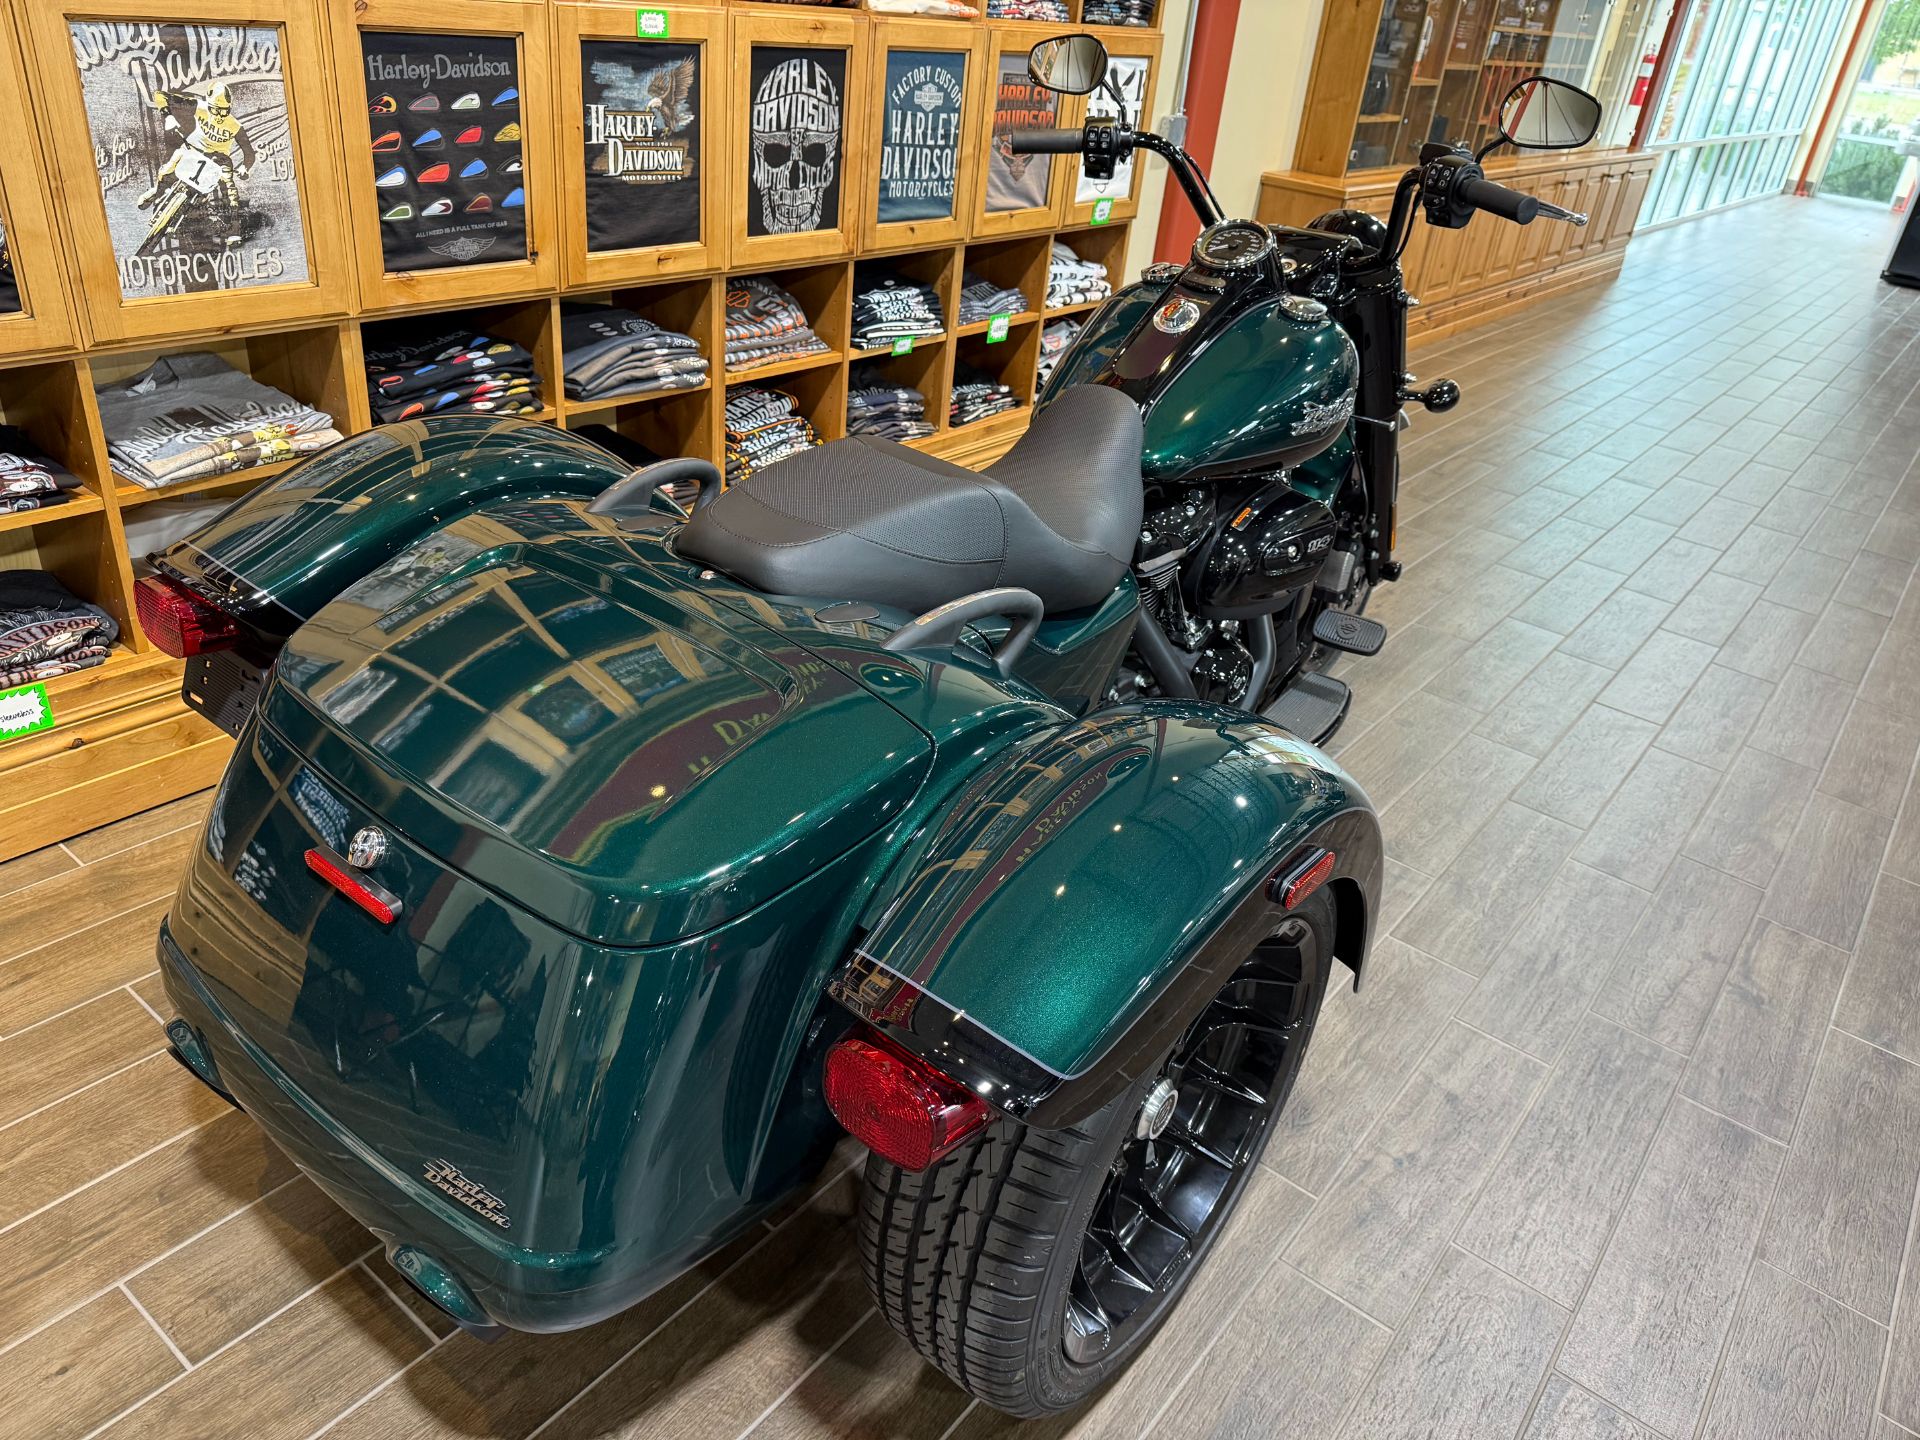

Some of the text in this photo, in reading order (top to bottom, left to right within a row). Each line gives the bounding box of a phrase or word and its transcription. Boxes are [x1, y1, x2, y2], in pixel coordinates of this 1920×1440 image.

[367, 52, 511, 88] Harley-Davidson
[892, 65, 931, 105] FACTORY
[198, 116, 234, 140] HARLEY
[585, 104, 658, 144] HARLEY-
[753, 94, 840, 133] DAVIDSON
[891, 110, 959, 145] HARLEY-
[189, 160, 206, 185] 1
[603, 137, 684, 177] DAVIDSON
[101, 158, 133, 193] peed
[889, 181, 954, 198] MOTORCYCLES
[0, 616, 98, 658] AVIDSON
[0, 708, 35, 723] sleeveless
